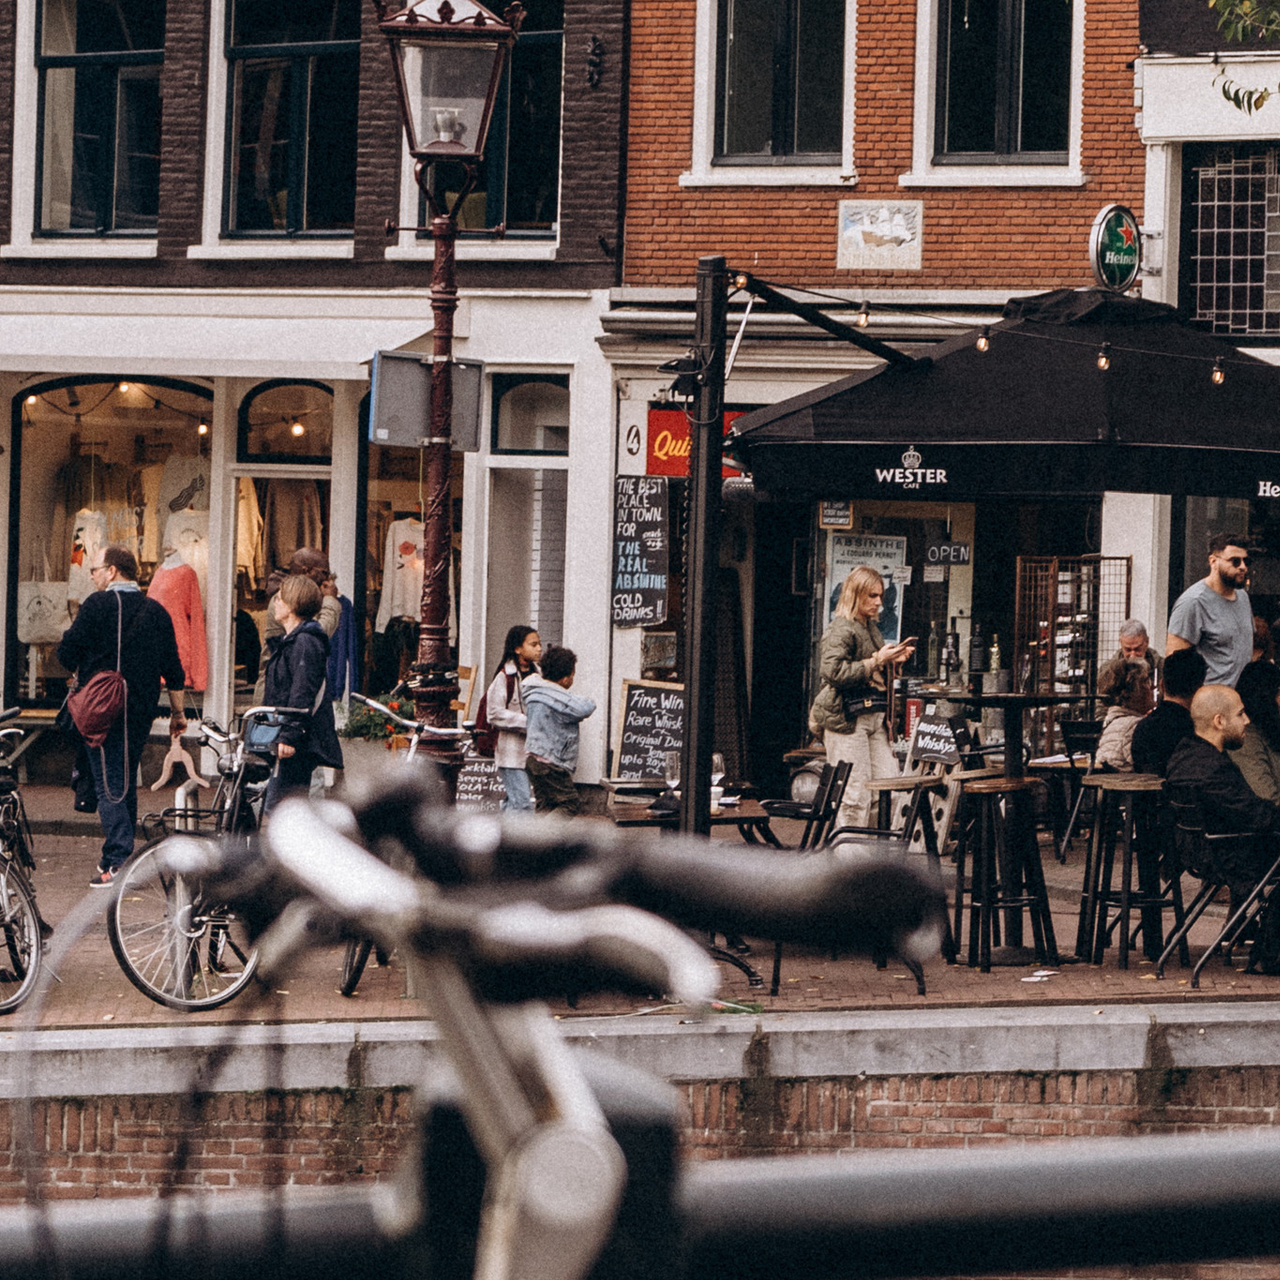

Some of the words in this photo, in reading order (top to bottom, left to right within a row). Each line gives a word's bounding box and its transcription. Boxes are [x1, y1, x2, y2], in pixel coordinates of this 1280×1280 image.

[1105, 251, 1137, 265] Heine
[627, 426, 640, 454] 4
[875, 468, 948, 483] WESTER
[617, 478, 635, 494] THE
[638, 478, 662, 494] BEST
[616, 493, 650, 508] PLACE
[617, 508, 628, 522] IN
[631, 507, 662, 522] TOWN
[616, 522, 637, 537] FOR
[617, 540, 641, 556] THE
[835, 536, 904, 549] ABSINTHE
[928, 545, 970, 561] OPEN
[617, 557, 649, 572] REAL
[613, 593, 642, 608] COLD
[613, 606, 654, 620] DRINKS
[630, 689, 658, 709] Fine
[661, 693, 684, 710] Win
[626, 710, 652, 727] Rare
[655, 714, 683, 730] Whisk
[623, 731, 662, 746] Original
[918, 735, 957, 754] Whiskys
[455, 792, 484, 800] ater
